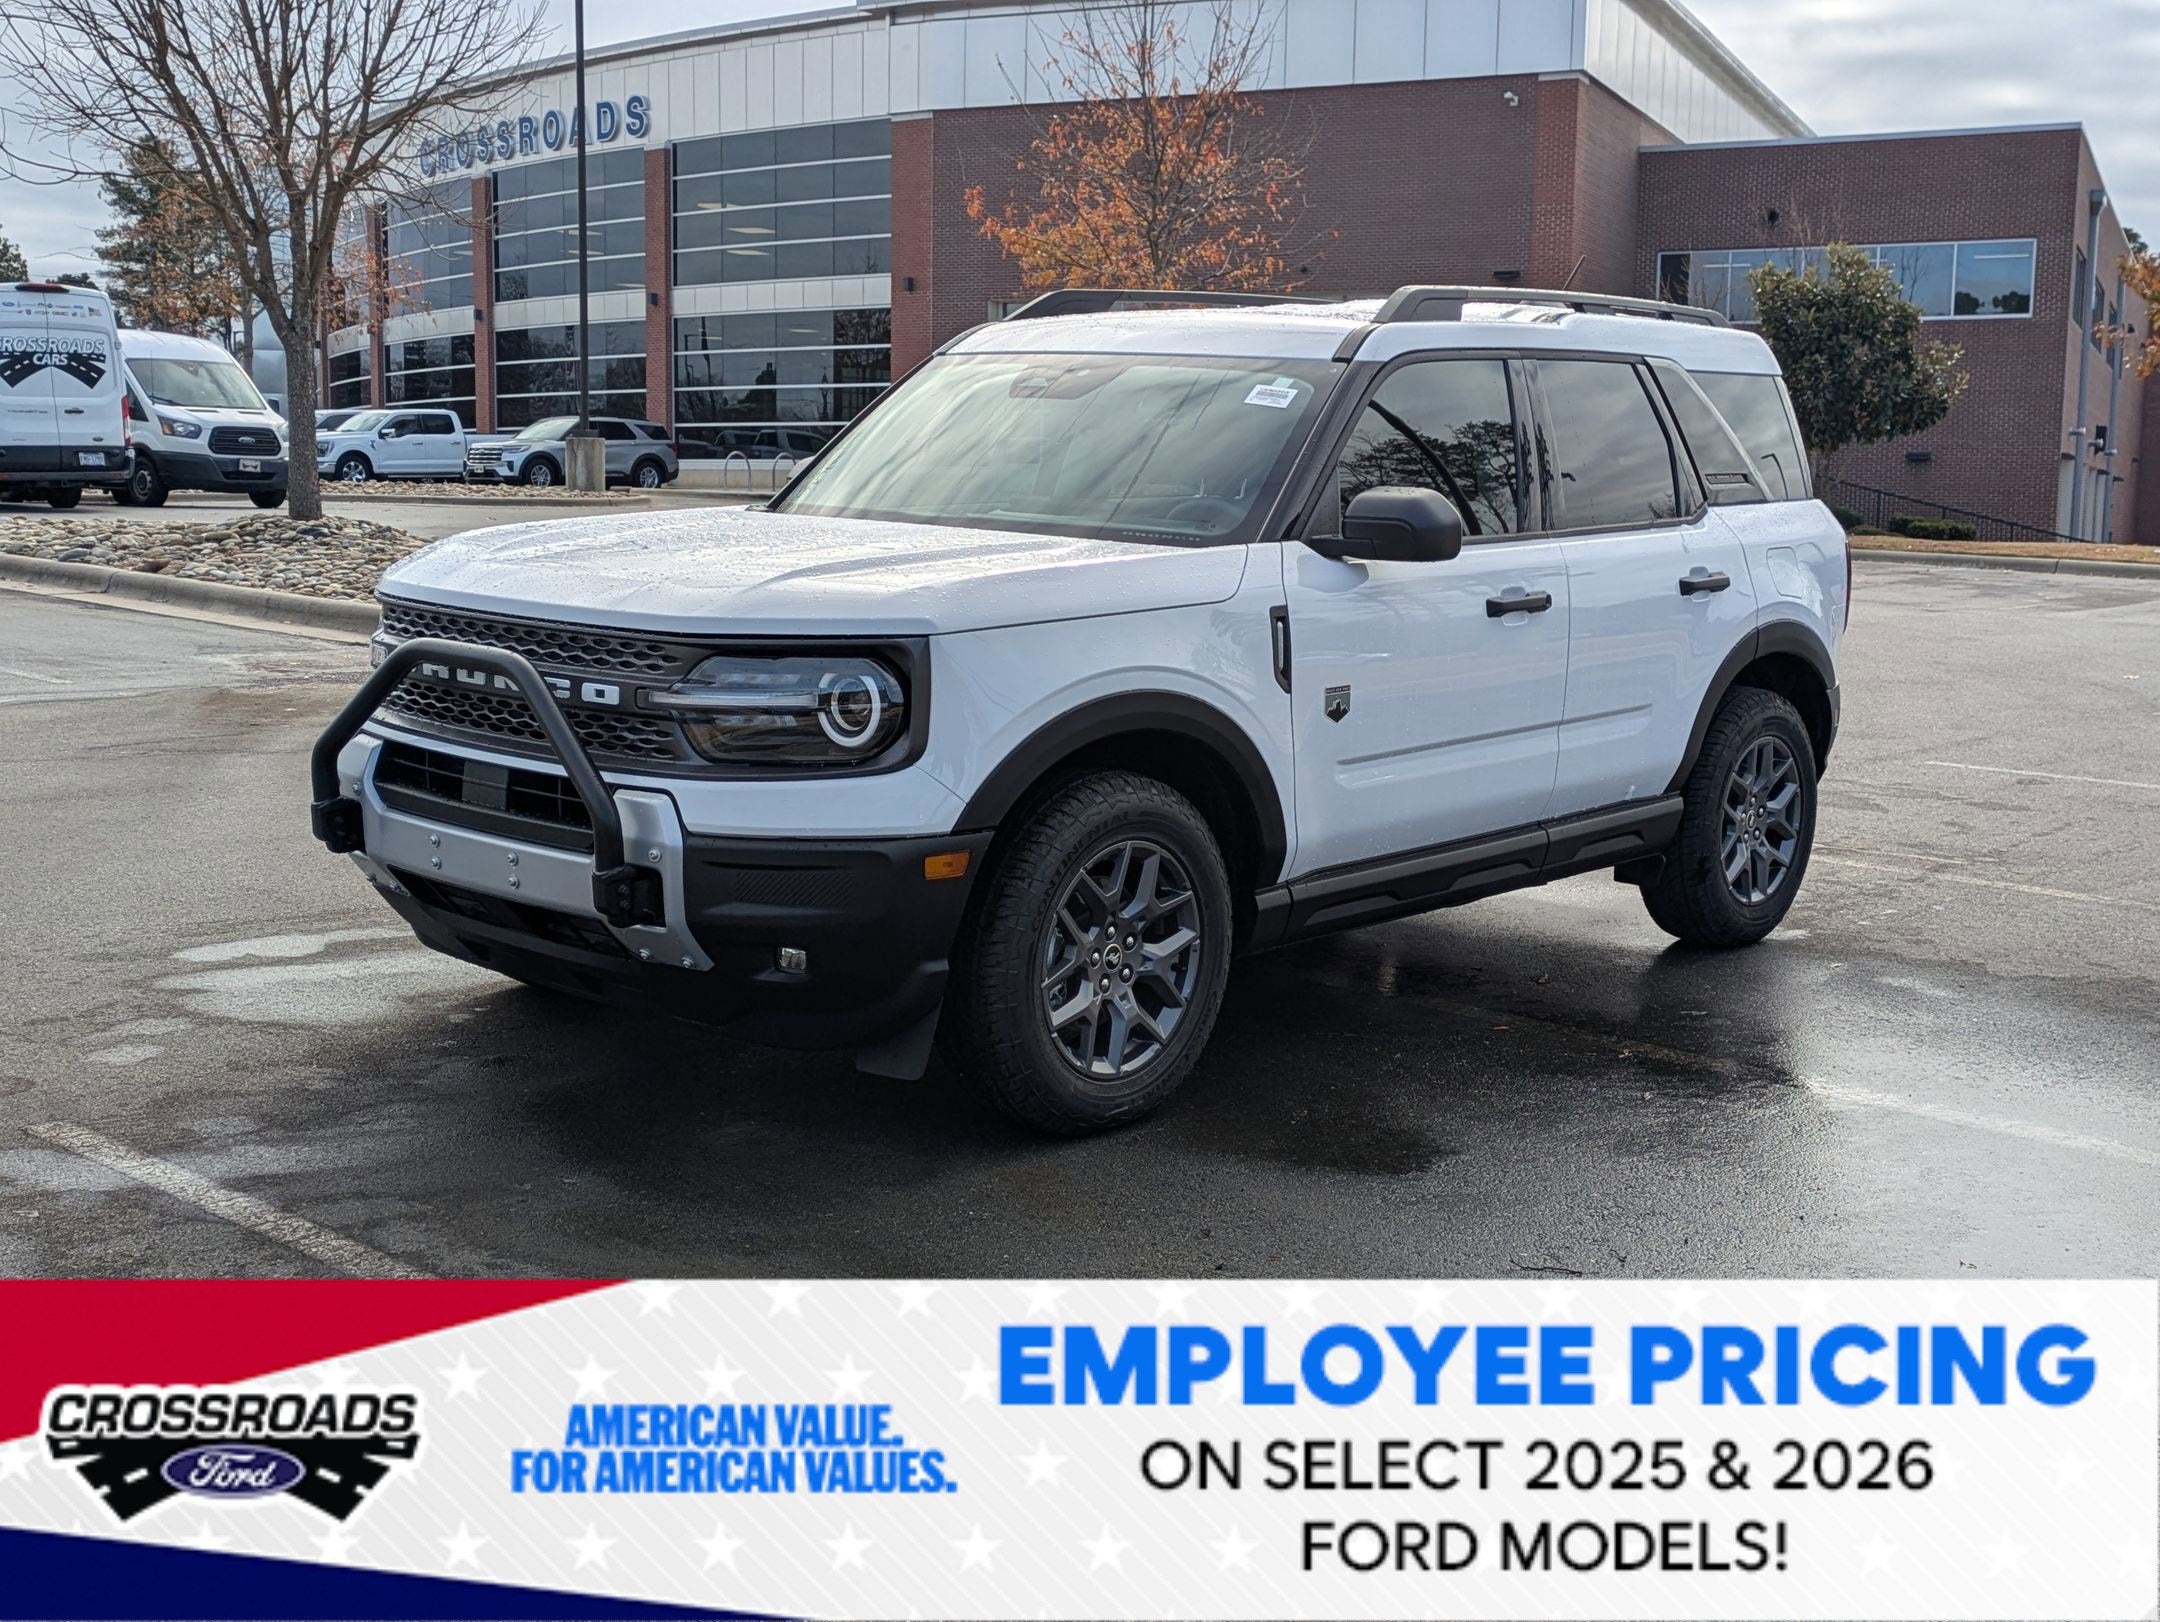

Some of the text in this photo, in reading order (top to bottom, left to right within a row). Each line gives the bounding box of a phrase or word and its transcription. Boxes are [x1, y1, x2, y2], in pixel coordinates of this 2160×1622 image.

[419, 95, 651, 177] CROSSROADS
[0, 336, 105, 353] ROSSROADS
[33, 353, 69, 366] CARS
[411, 663, 620, 706] RONCO
